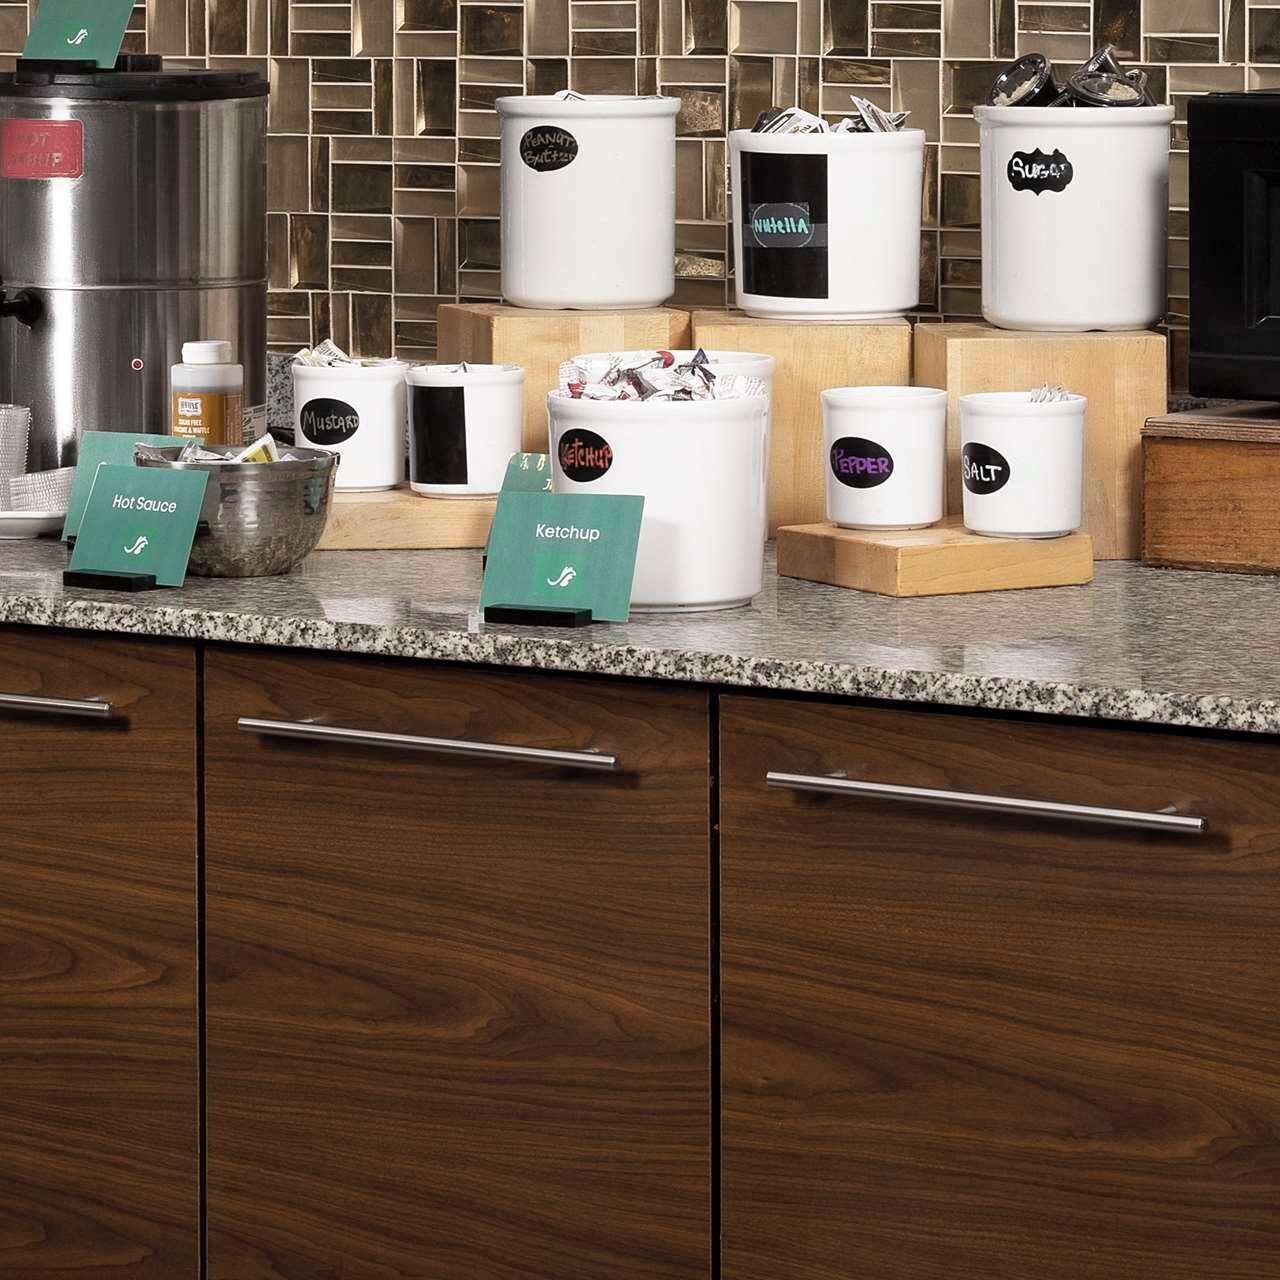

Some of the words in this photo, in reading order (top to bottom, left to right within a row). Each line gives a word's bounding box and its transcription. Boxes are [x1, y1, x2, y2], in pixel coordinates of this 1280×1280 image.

[832, 448, 891, 475] PEPPER
[962, 455, 1002, 482] SALT
[112, 494, 135, 509] Hot
[136, 496, 177, 513] Sauce
[535, 523, 600, 542] Ketchup
